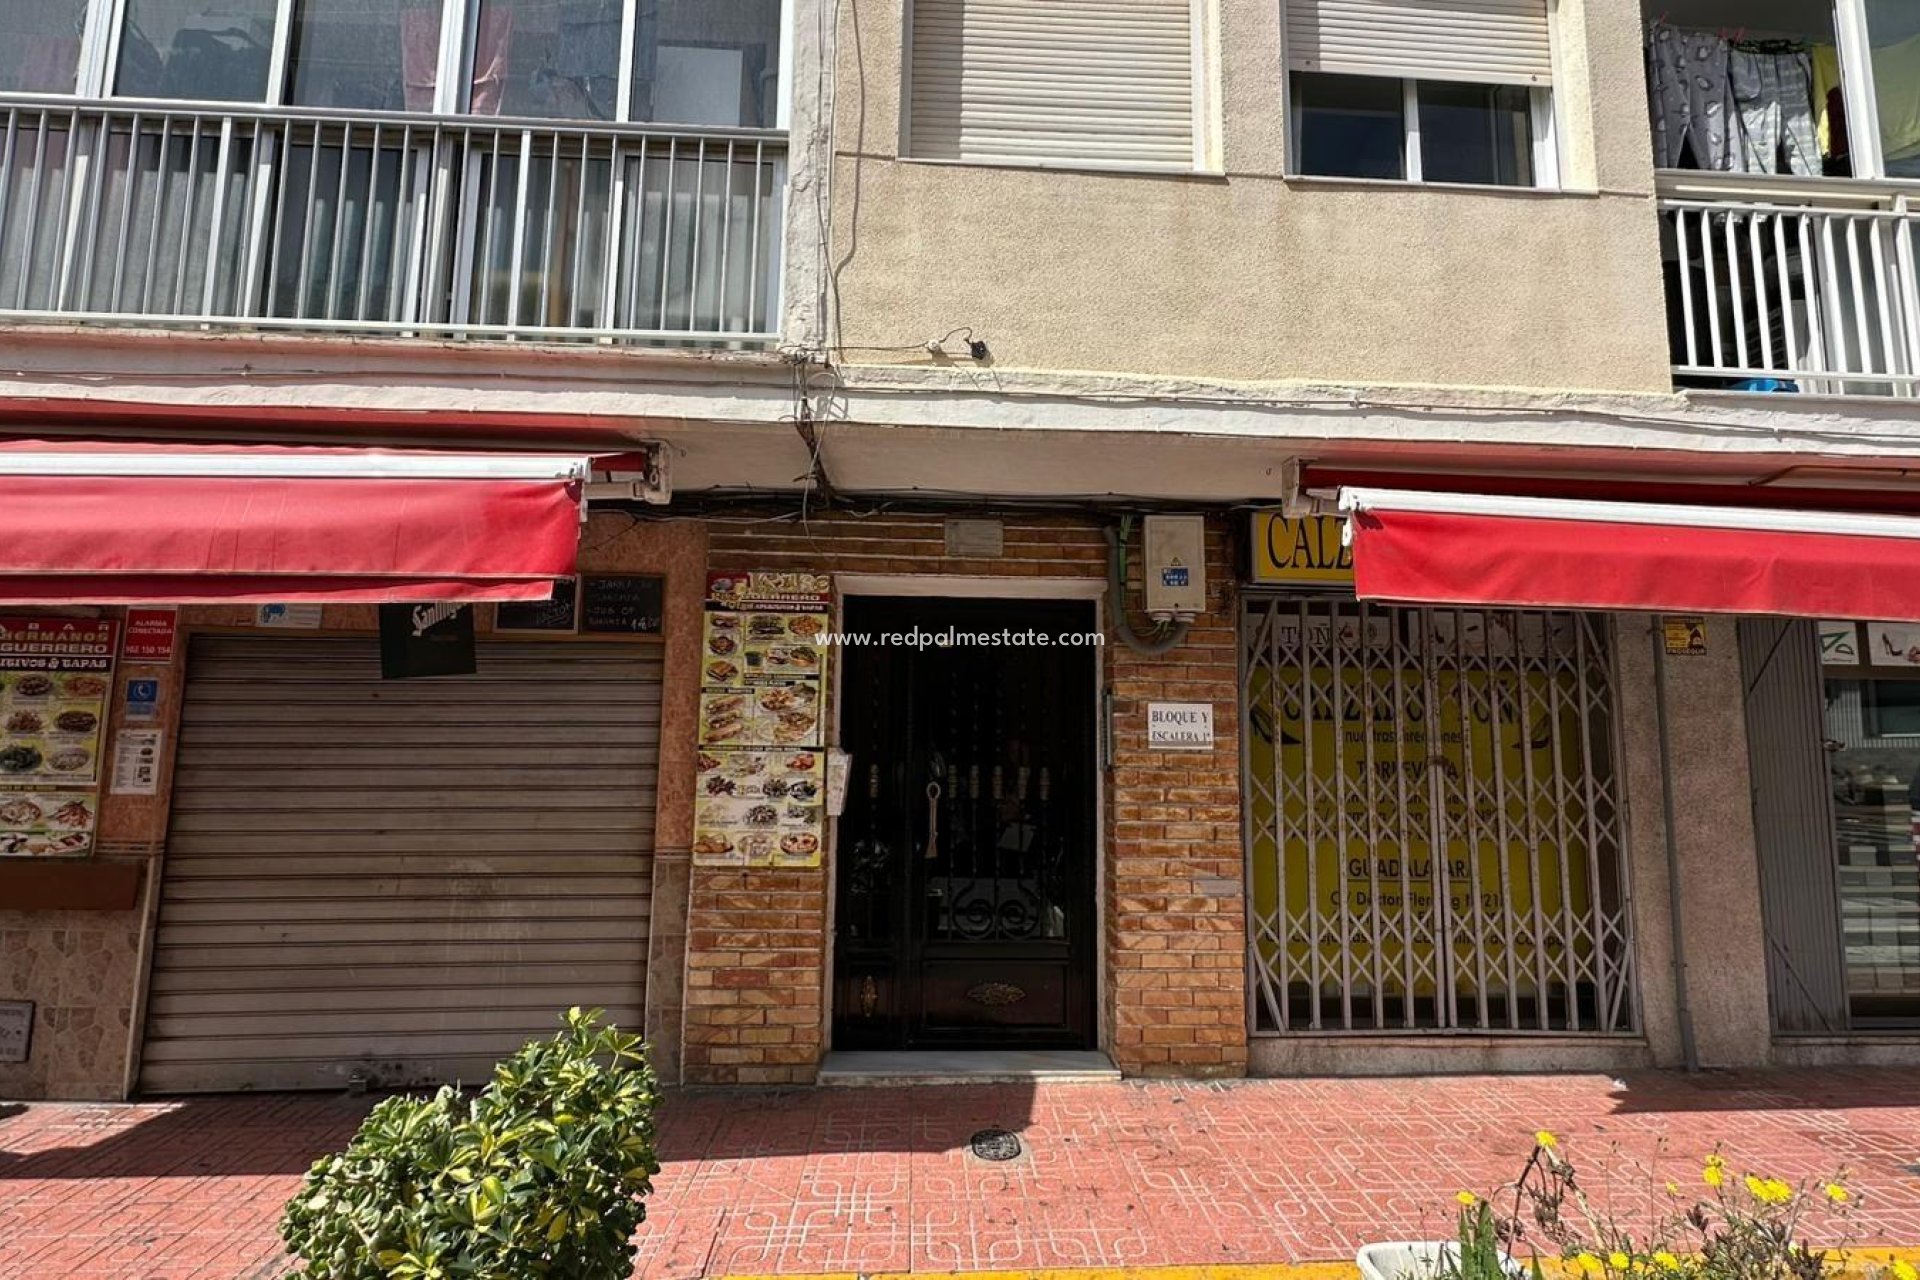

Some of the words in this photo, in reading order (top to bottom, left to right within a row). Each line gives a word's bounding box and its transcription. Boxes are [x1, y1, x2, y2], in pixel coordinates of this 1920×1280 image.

[1, 643, 107, 654] GUERRERO
[62, 658, 107, 669] TAPAS
[1152, 710, 1198, 725] BLOQUE
[1202, 712, 1208, 723] Y
[1152, 731, 1198, 742] ESCALERA
[1357, 892, 1402, 906] Dotor
